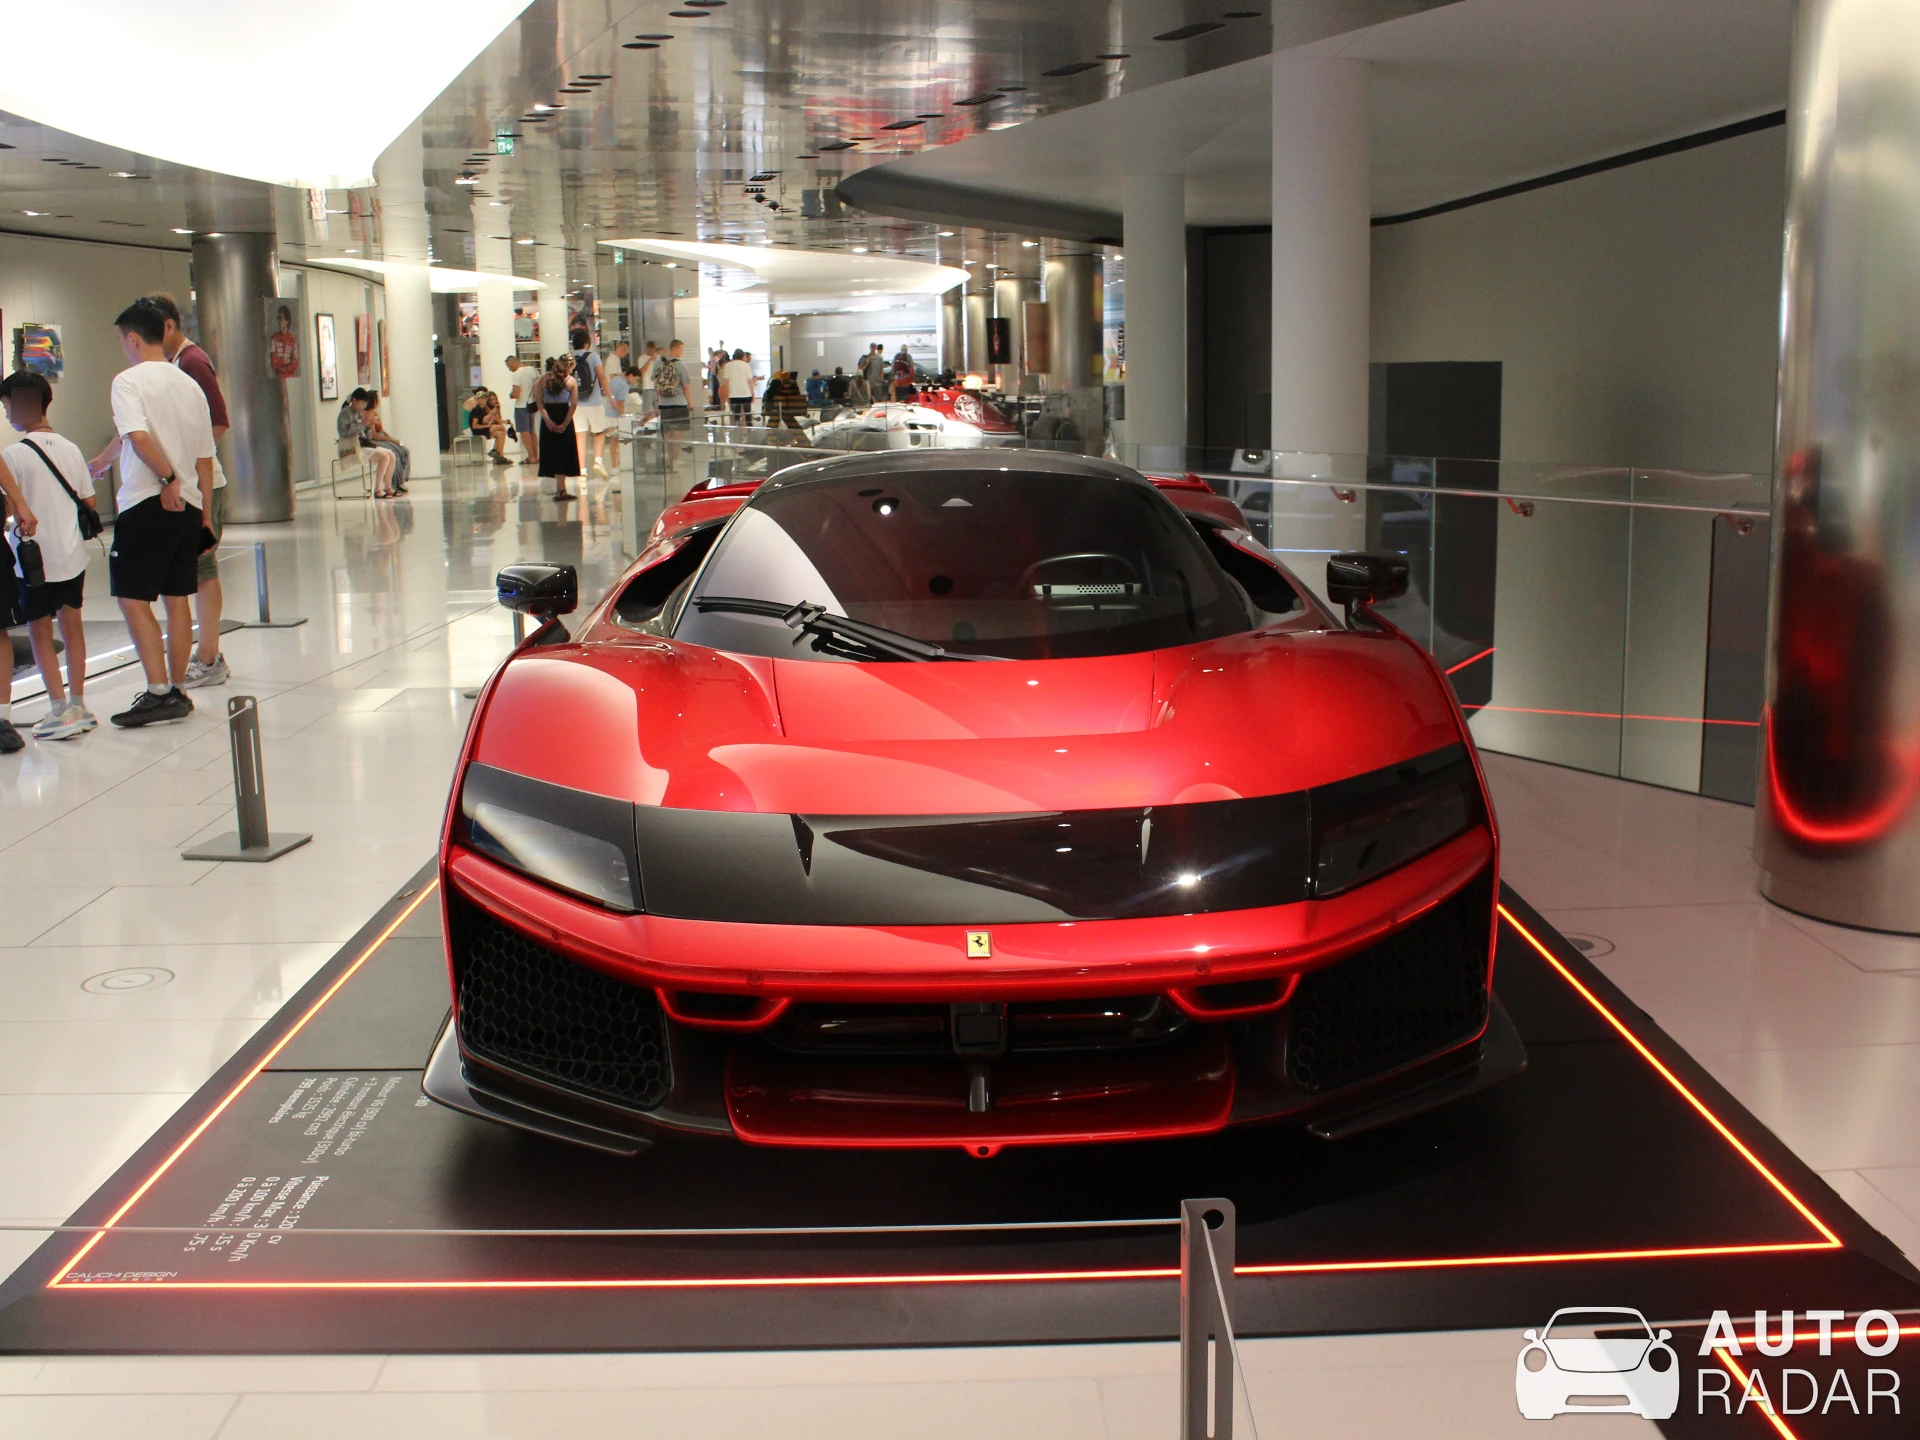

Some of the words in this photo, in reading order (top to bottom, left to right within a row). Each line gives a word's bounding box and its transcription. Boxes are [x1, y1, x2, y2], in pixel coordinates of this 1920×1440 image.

[299, 1078, 317, 1088] 799
[317, 1078, 338, 1092] Poids
[330, 1078, 358, 1103] Cylindrée
[378, 1077, 401, 1098] Moteur
[269, 1089, 304, 1123] exemplaires
[302, 1097, 322, 1110] 1525
[346, 1087, 371, 1110] moteurs
[315, 1108, 336, 1121] 2992
[304, 1123, 321, 1135] cm3
[334, 1131, 364, 1155] bi-turbo
[225, 1189, 246, 1202] 200
[250, 1189, 270, 1201] 100
[275, 1176, 305, 1200] Vitesse
[293, 1176, 329, 1209] Puissance
[207, 1203, 236, 1222] km/h
[233, 1203, 261, 1221] km/h
[261, 1202, 285, 1217] Max
[277, 1215, 299, 1230] 120
[189, 1230, 210, 1245] .75
[216, 1230, 235, 1245] .15
[247, 1224, 268, 1237] 30
[268, 1235, 282, 1244] cv
[228, 1240, 257, 1261] Km/h
